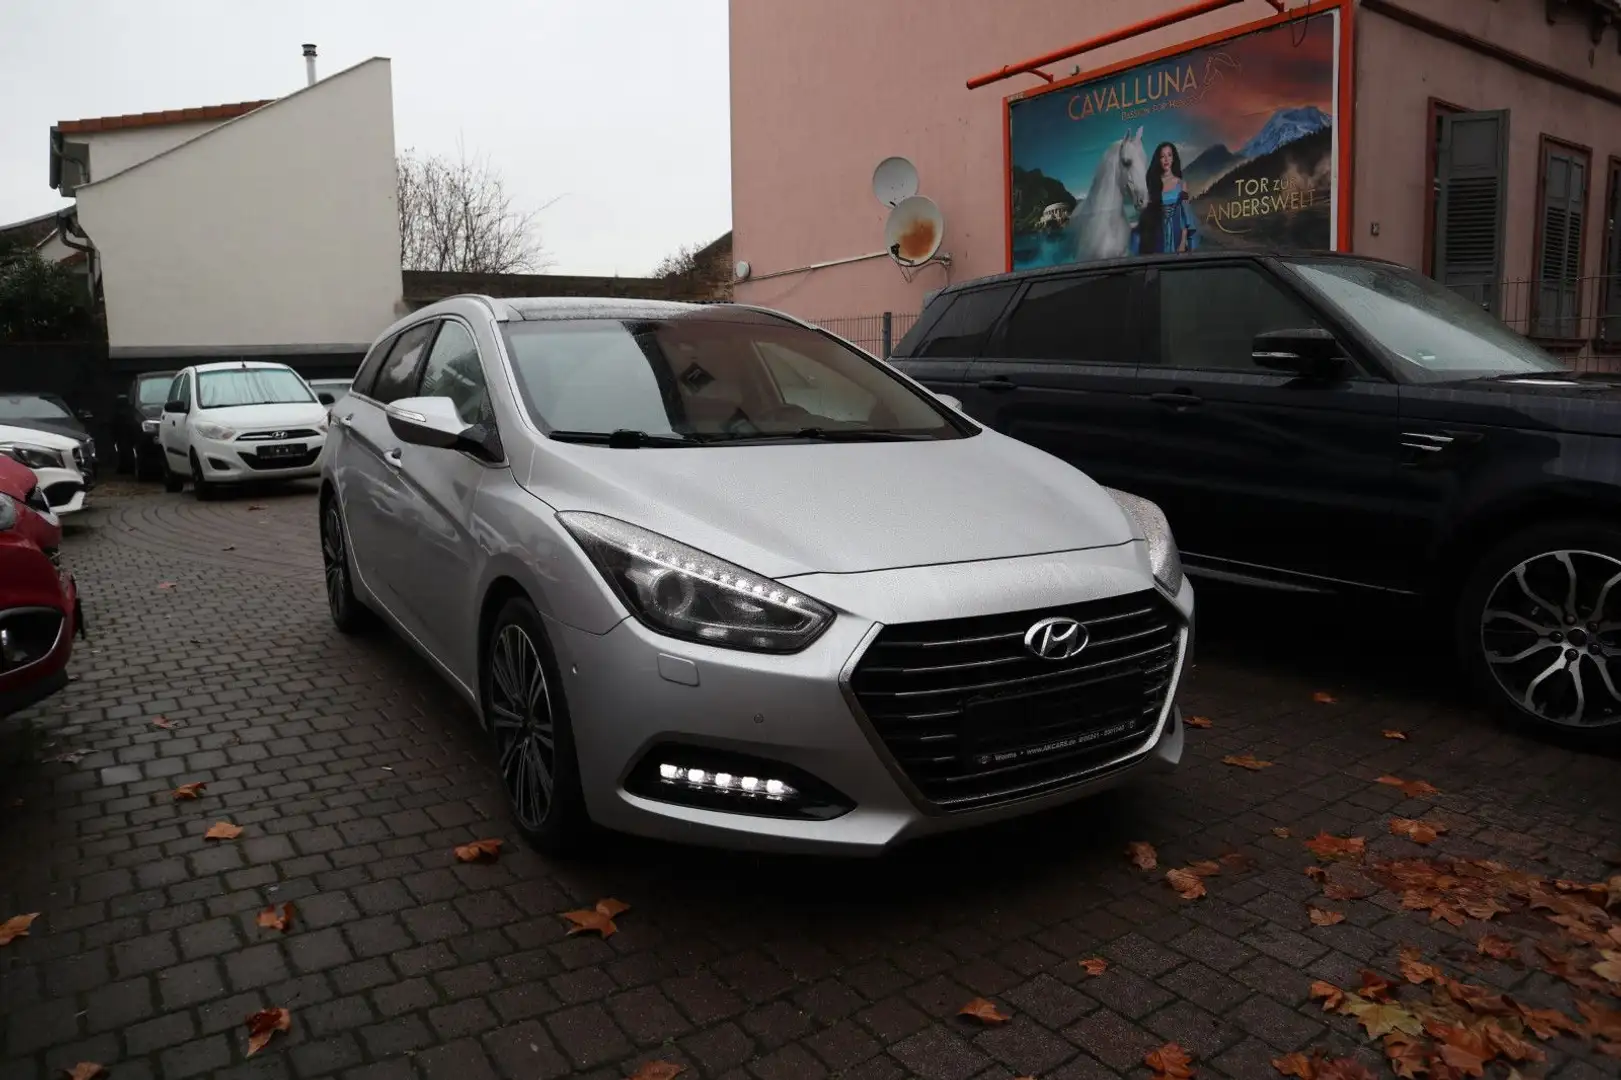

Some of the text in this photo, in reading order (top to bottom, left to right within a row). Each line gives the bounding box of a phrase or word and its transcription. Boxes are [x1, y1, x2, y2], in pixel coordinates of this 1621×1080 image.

[1068, 64, 1198, 121] CAVALLUNA
[1235, 177, 1297, 197] TOR ZUR
[1205, 188, 1316, 234] ANDERSWELT
